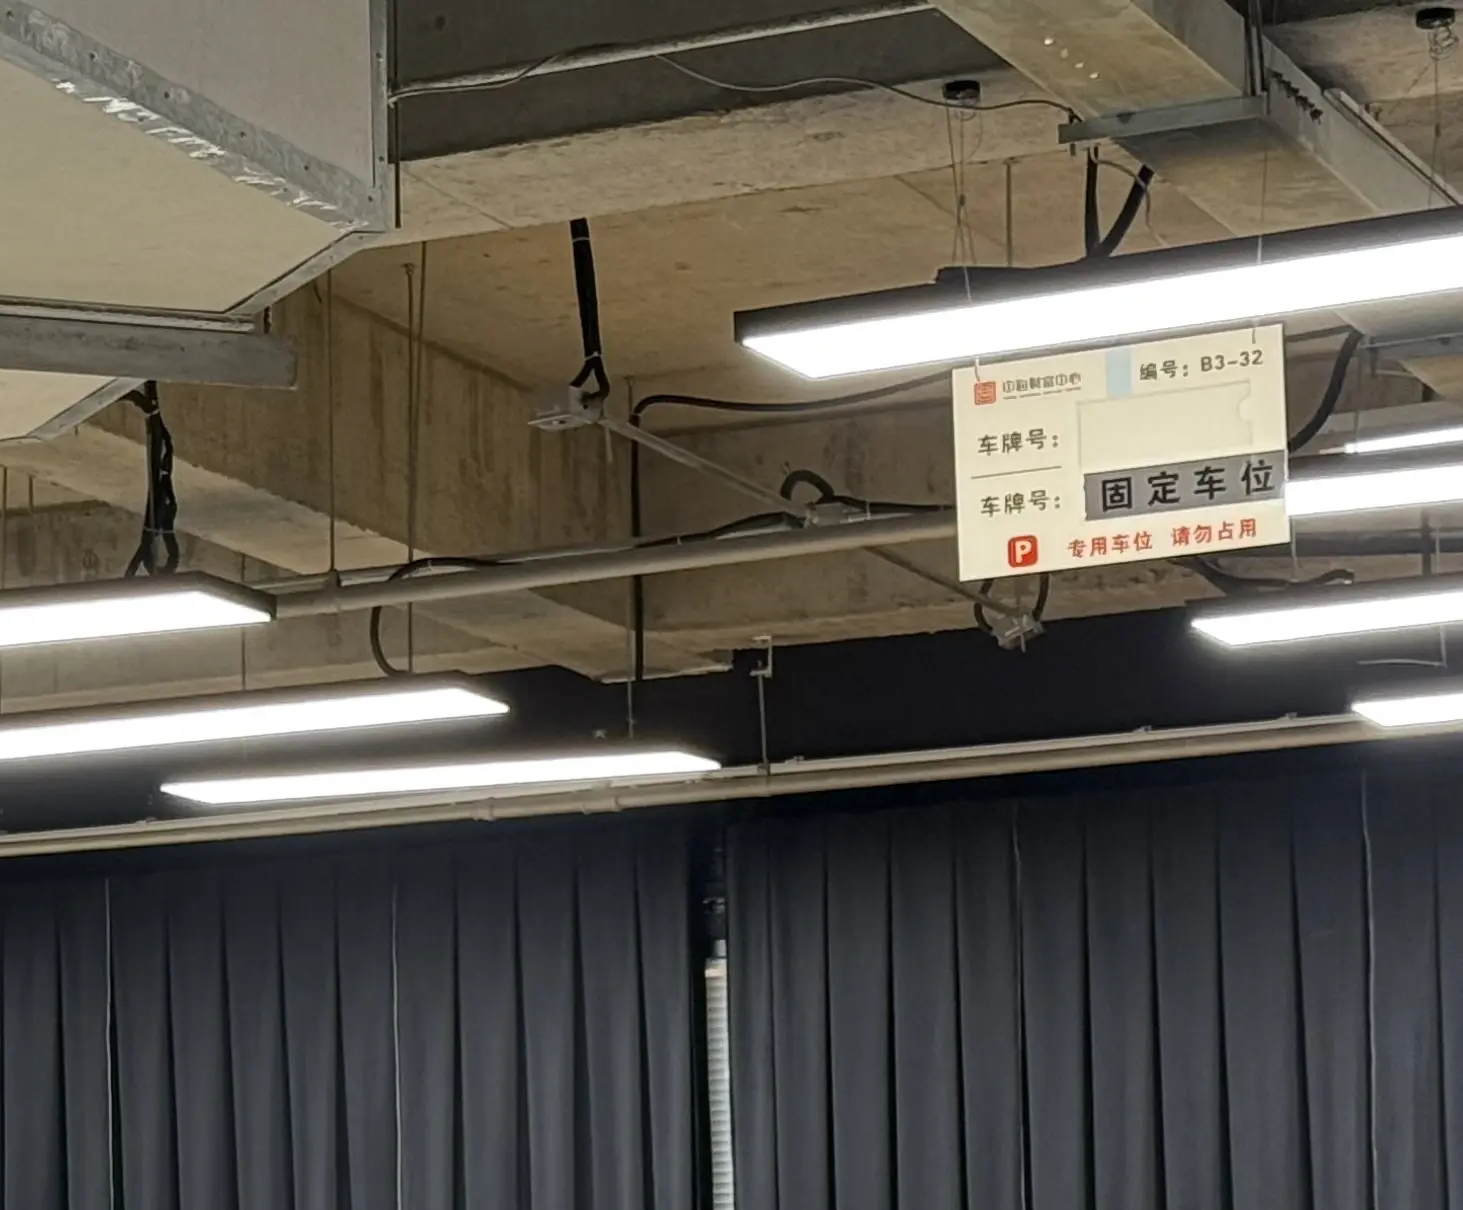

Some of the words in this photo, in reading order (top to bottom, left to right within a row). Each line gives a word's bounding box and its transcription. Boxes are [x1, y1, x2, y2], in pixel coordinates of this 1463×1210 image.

[1200, 350, 1264, 373] B3-32
[1100, 459, 1275, 513] 固定车位
[1067, 530, 1153, 558] 专用车位
[1171, 518, 1258, 548] 请勿占用
